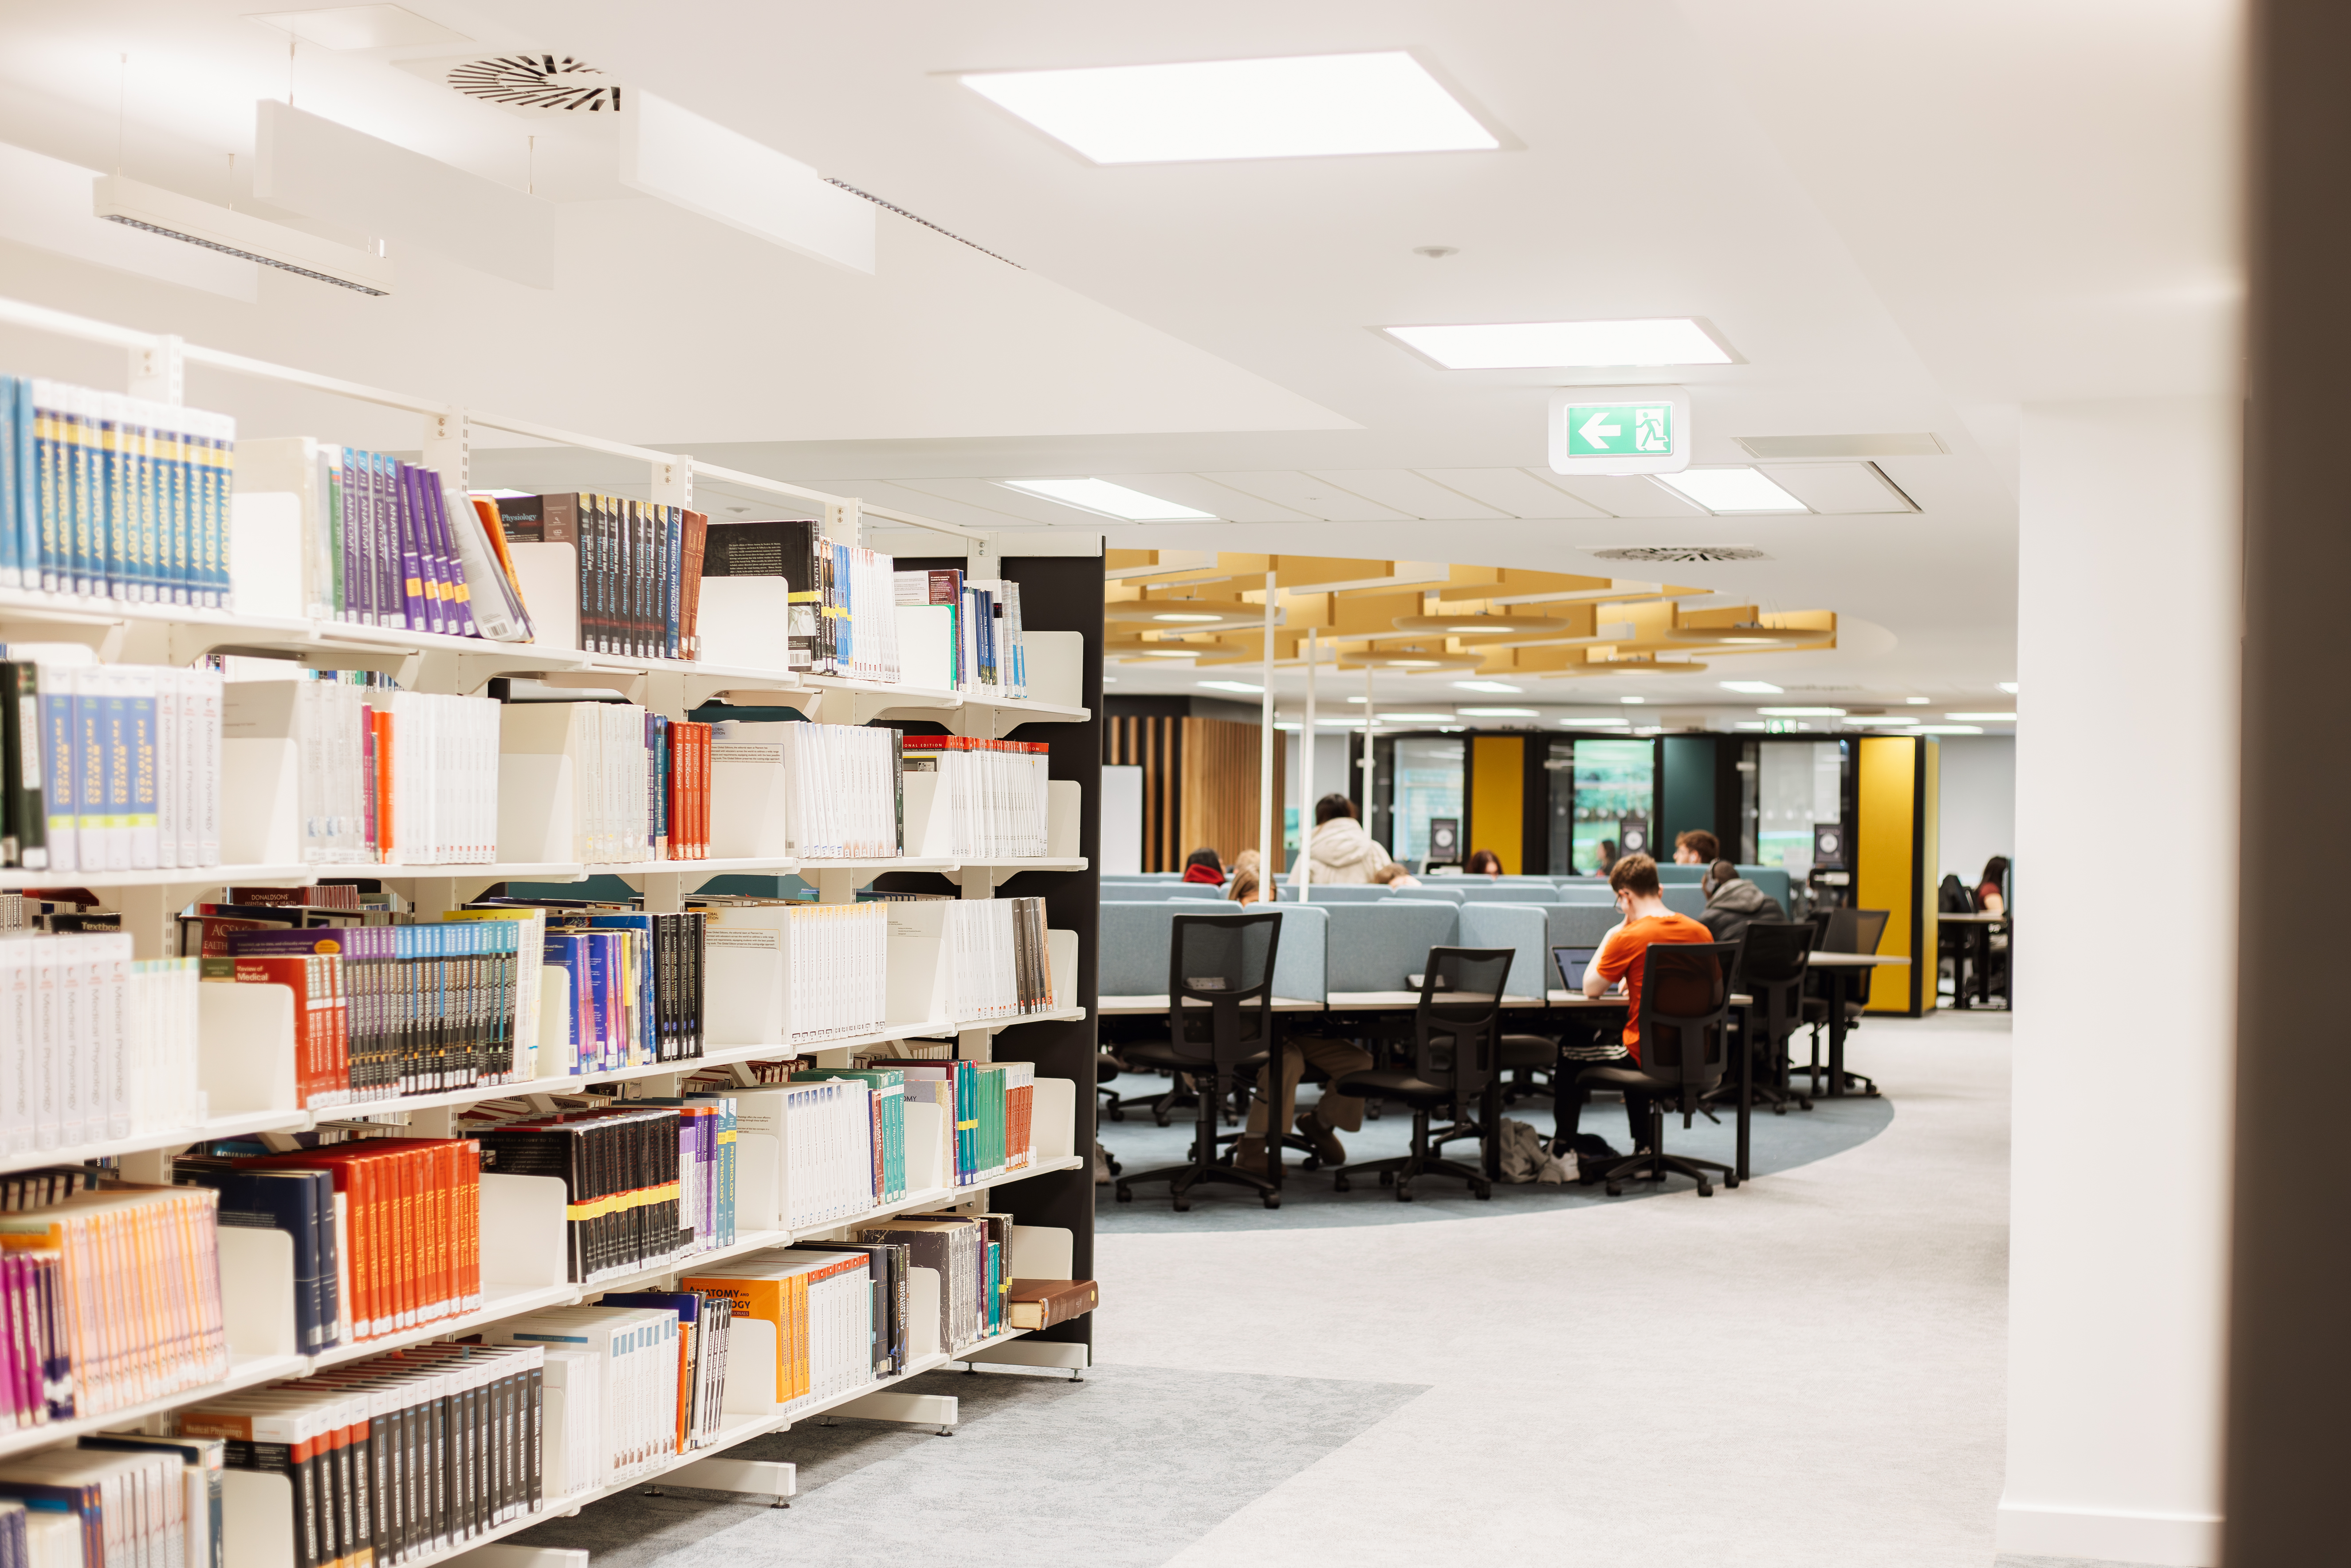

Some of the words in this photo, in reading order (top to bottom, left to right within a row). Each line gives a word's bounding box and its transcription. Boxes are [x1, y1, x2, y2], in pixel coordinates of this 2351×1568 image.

[501, 513, 537, 523] Physiology
[389, 503, 398, 561] ANATOMY
[82, 922, 120, 931] Textboo
[204, 941, 227, 950] EALTH
[358, 1489, 366, 1539] Physiology
